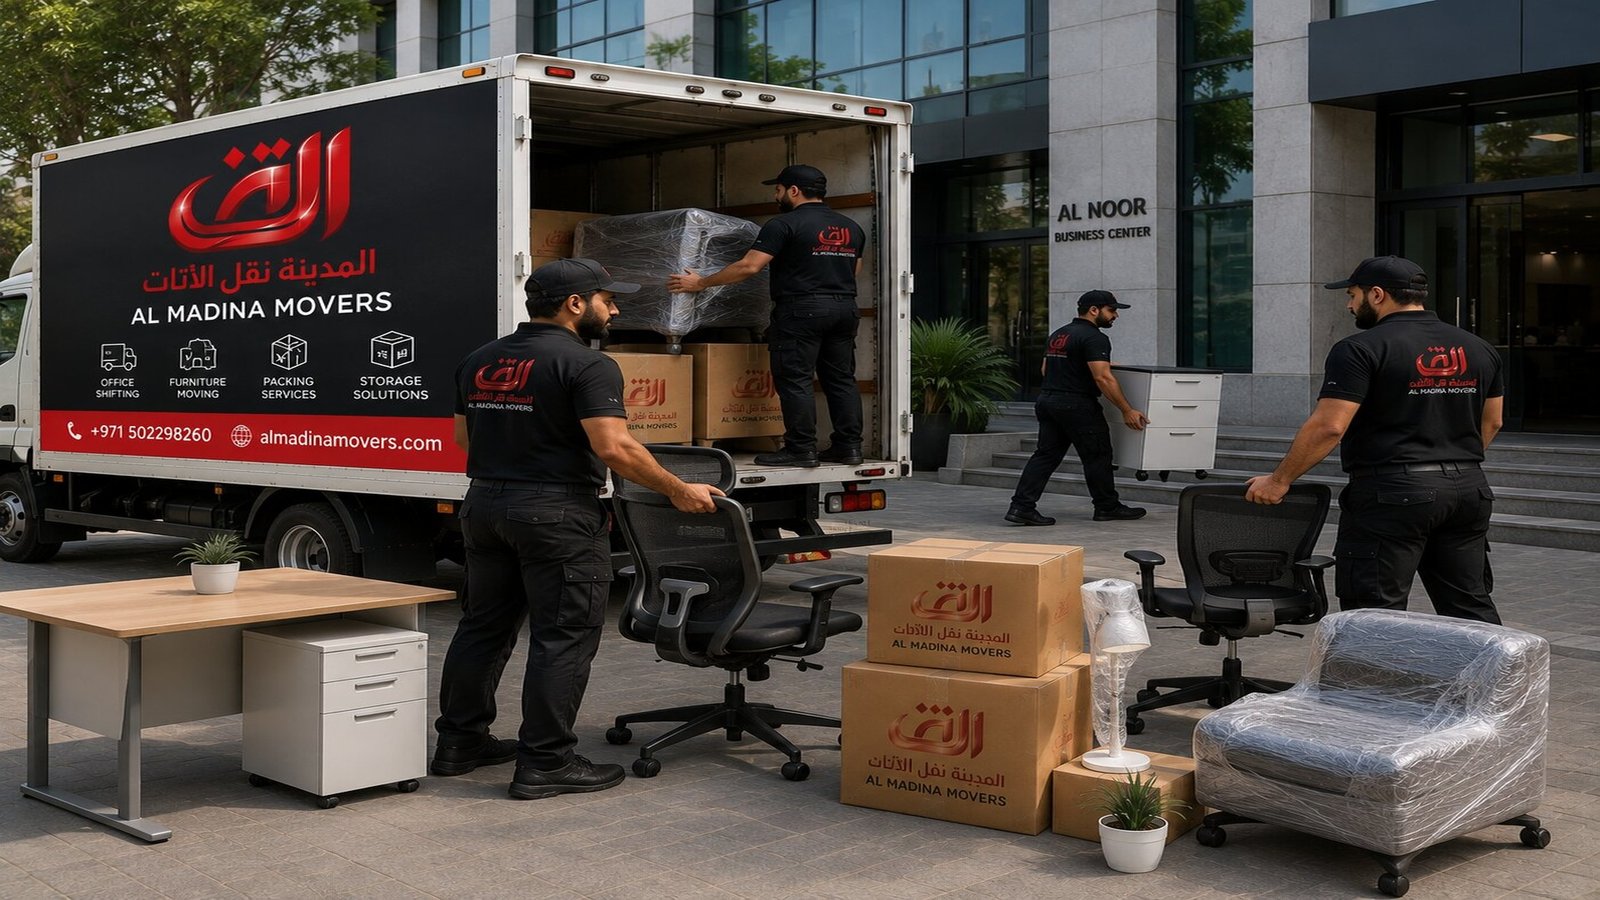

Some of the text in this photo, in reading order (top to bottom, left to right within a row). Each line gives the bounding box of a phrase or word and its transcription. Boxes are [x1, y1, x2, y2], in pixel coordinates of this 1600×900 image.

[1057, 197, 1147, 222] AL NOOR
[1055, 226, 1151, 243] BUSINESS CENTER
[278, 248, 376, 287] المدينة
[220, 260, 271, 294] نقل
[131, 291, 392, 325] AL MADINA MOVERS
[100, 378, 134, 387] OFFICE
[169, 377, 226, 387] FURNITURE
[263, 376, 314, 386] PACKING
[360, 375, 422, 386] STORAGE
[96, 389, 140, 398] SHIFTING
[177, 389, 219, 398] MOVING
[261, 388, 316, 399] SERVICES
[353, 389, 429, 400] SOLUTIONS
[91, 424, 212, 442] +971 502298260
[260, 429, 442, 451] almadinamovers.com
[892, 640, 1011, 658] AL MADINA MOVERS
[865, 775, 1006, 807] AL MADINA MOVERS
